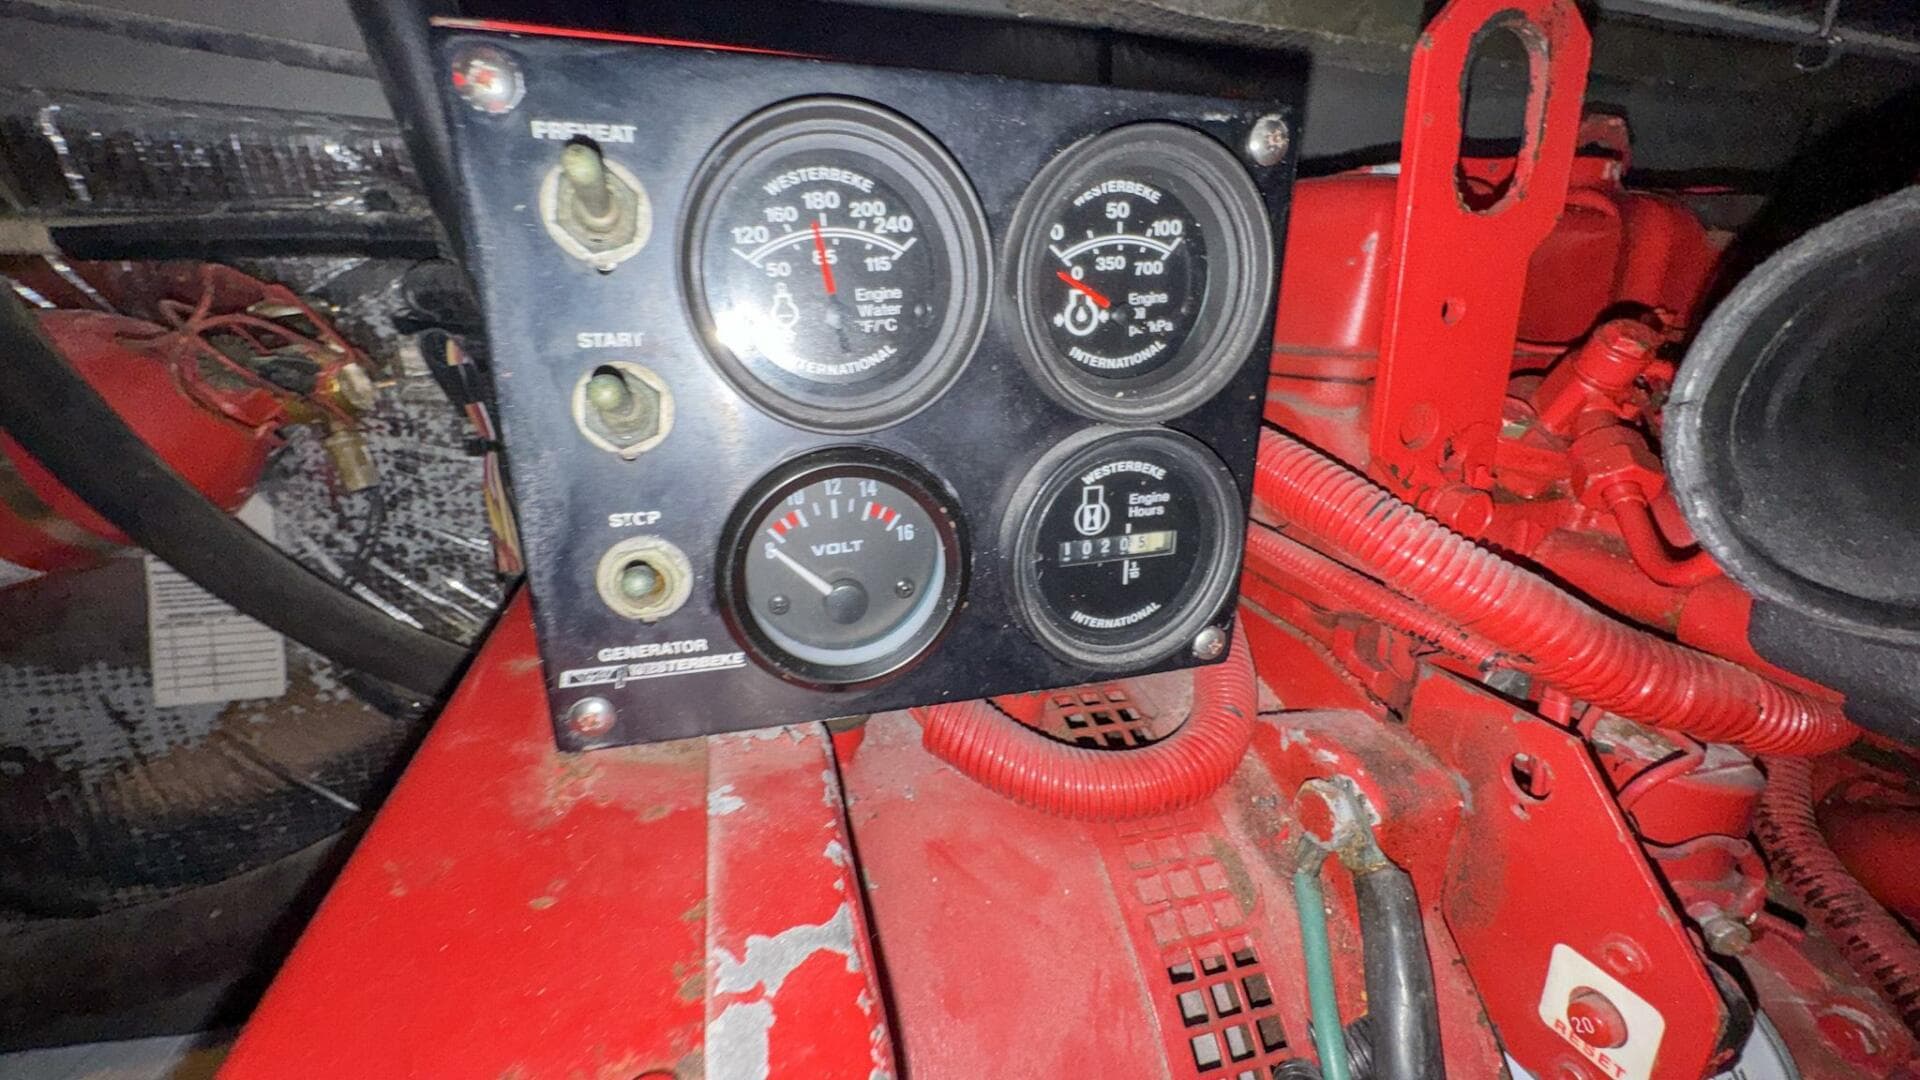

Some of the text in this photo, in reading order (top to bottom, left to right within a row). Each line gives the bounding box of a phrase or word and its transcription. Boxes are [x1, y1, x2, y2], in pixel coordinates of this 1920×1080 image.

[763, 167, 875, 195] WESTERBEKE
[801, 191, 841, 209] 180
[764, 206, 798, 222] 160
[849, 202, 886, 217] 200
[1105, 202, 1130, 218] 50
[873, 217, 913, 234] 240
[1051, 224, 1064, 240] 0
[1151, 220, 1182, 236] 100
[731, 226, 770, 244] 120
[765, 262, 792, 278] 50
[863, 257, 893, 272] 115
[1095, 257, 1126, 271] 350
[1134, 261, 1163, 276] 700
[1071, 266, 1084, 281] 0
[855, 287, 903, 303] Engine
[1128, 291, 1168, 306] Engine
[856, 304, 903, 317] Water
[577, 332, 644, 348] START
[1069, 341, 1167, 369] INTERNATIONAL
[1081, 460, 1167, 485] WESTERBEKE
[824, 479, 842, 496] 12
[859, 480, 878, 497] 14
[1129, 491, 1171, 505] Engine
[1128, 505, 1165, 518] Hours
[897, 524, 914, 541] 16
[811, 539, 864, 556] VOLT
[1070, 602, 1162, 629] INTERNATIONAL
[597, 638, 709, 662] GENERATOR
[628, 652, 747, 677] WESTERBEKE
[1571, 1016, 1595, 1034] 20
[1553, 1019, 1627, 1079] RESET
